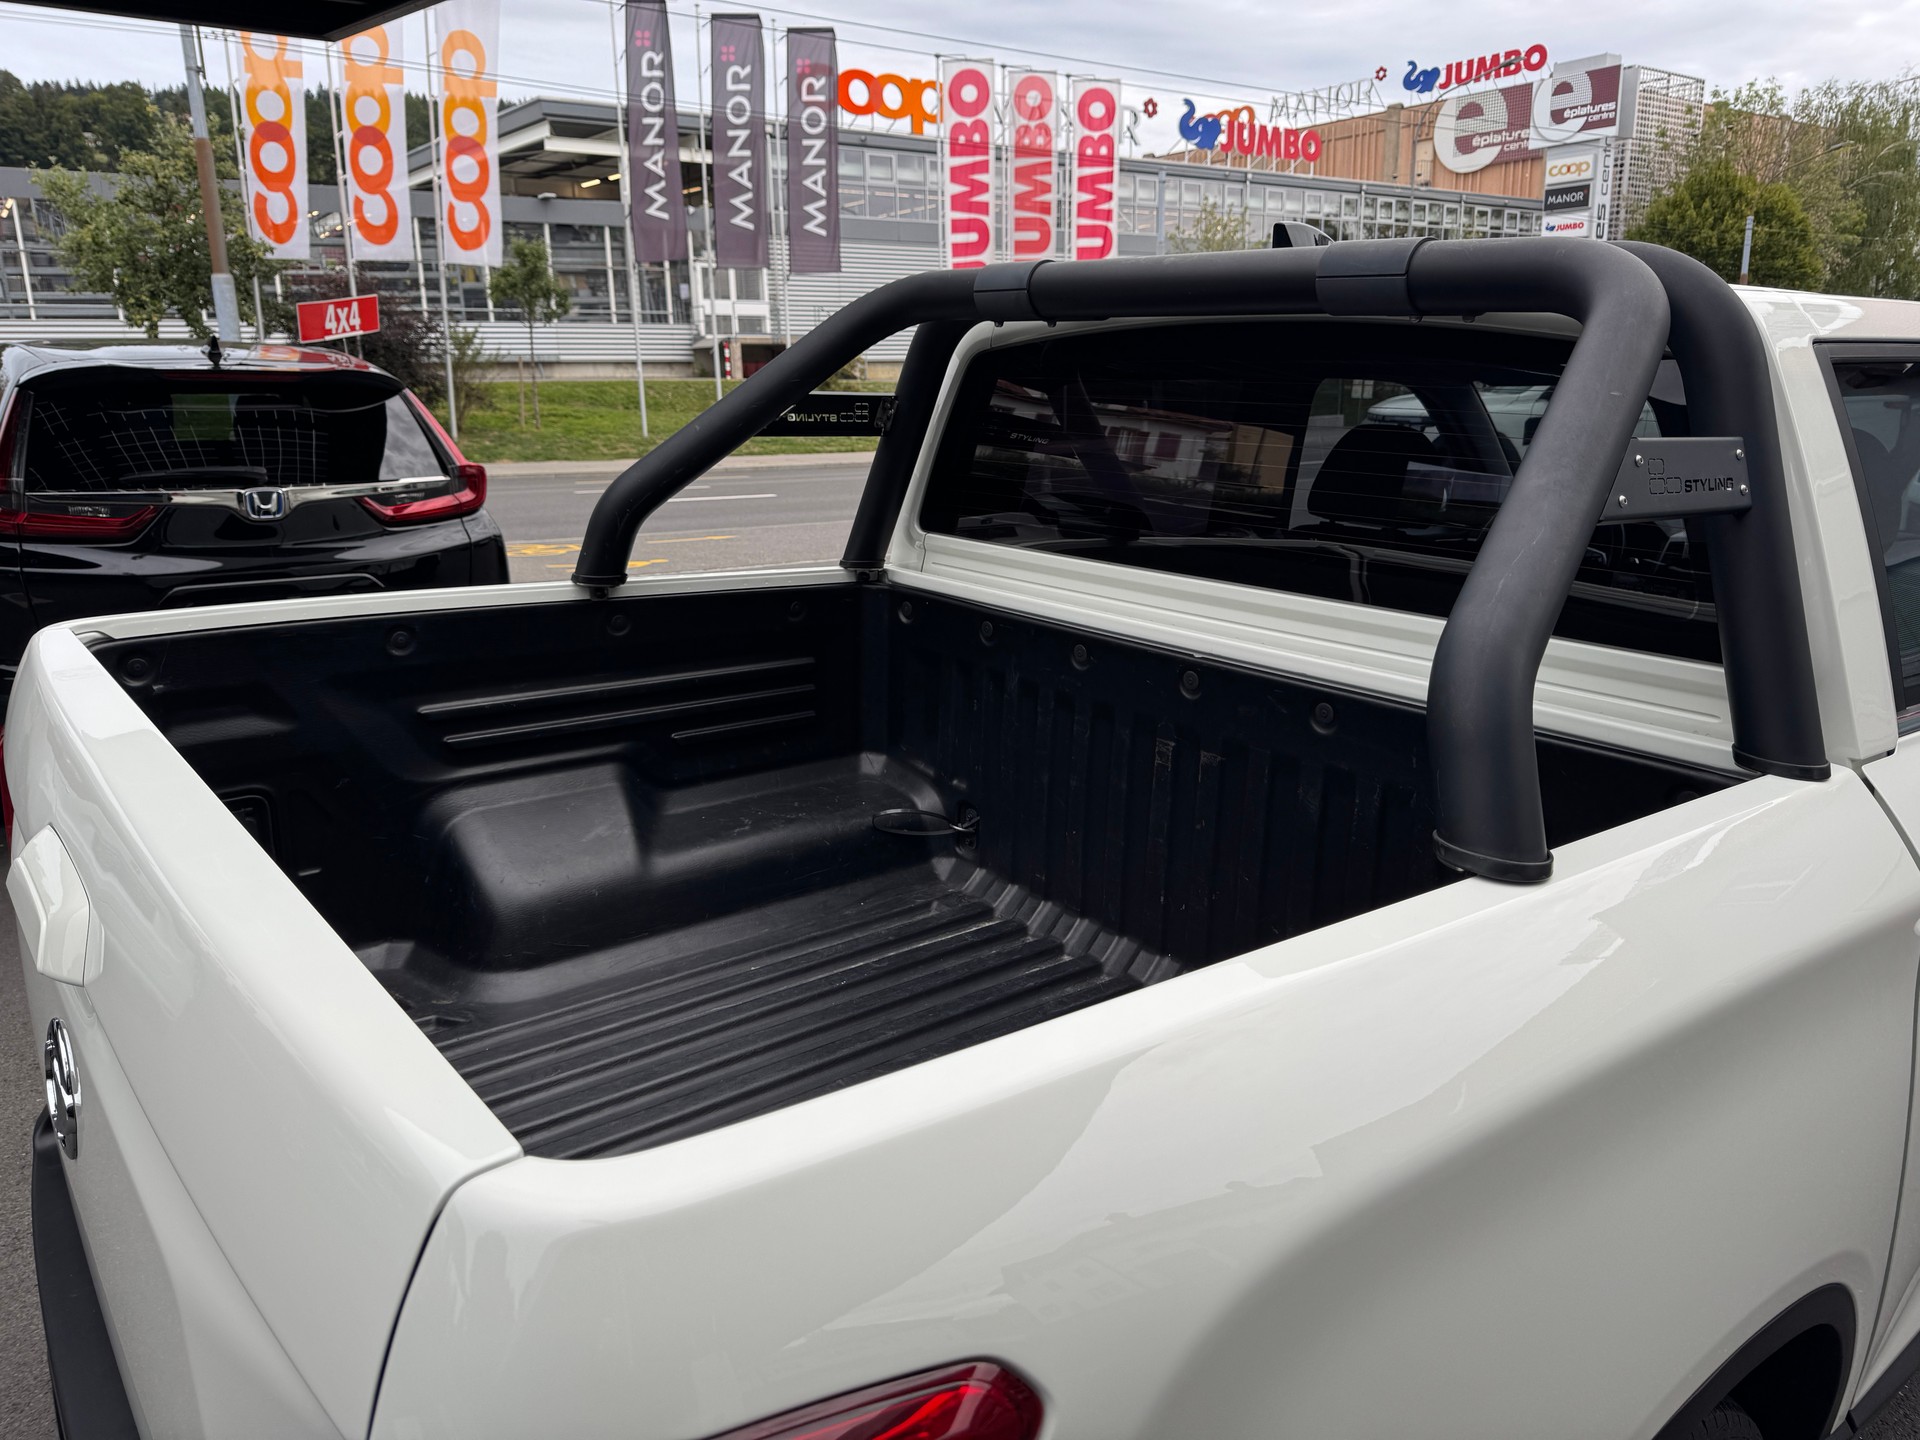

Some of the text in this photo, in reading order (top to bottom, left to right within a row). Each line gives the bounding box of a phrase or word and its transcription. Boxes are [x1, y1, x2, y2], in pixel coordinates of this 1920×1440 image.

[1439, 43, 1548, 90] JUMBO
[838, 69, 943, 135] oop
[1270, 79, 1373, 123] MANOR
[340, 25, 404, 246] coop
[442, 29, 498, 251] coop
[641, 51, 670, 220] MANOR
[726, 64, 755, 231] MANOR
[800, 76, 827, 237] MANOR
[1219, 119, 1322, 162] JUMBO
[1472, 128, 1530, 149] éplature
[1014, 75, 1053, 261] UMBO
[1076, 87, 1117, 260] UMBO
[1548, 160, 1590, 177] coop
[1547, 191, 1584, 206] MANOR
[1556, 221, 1584, 232] JUMBO
[324, 301, 361, 333] 4x4
[1684, 477, 1734, 493] STYLING
